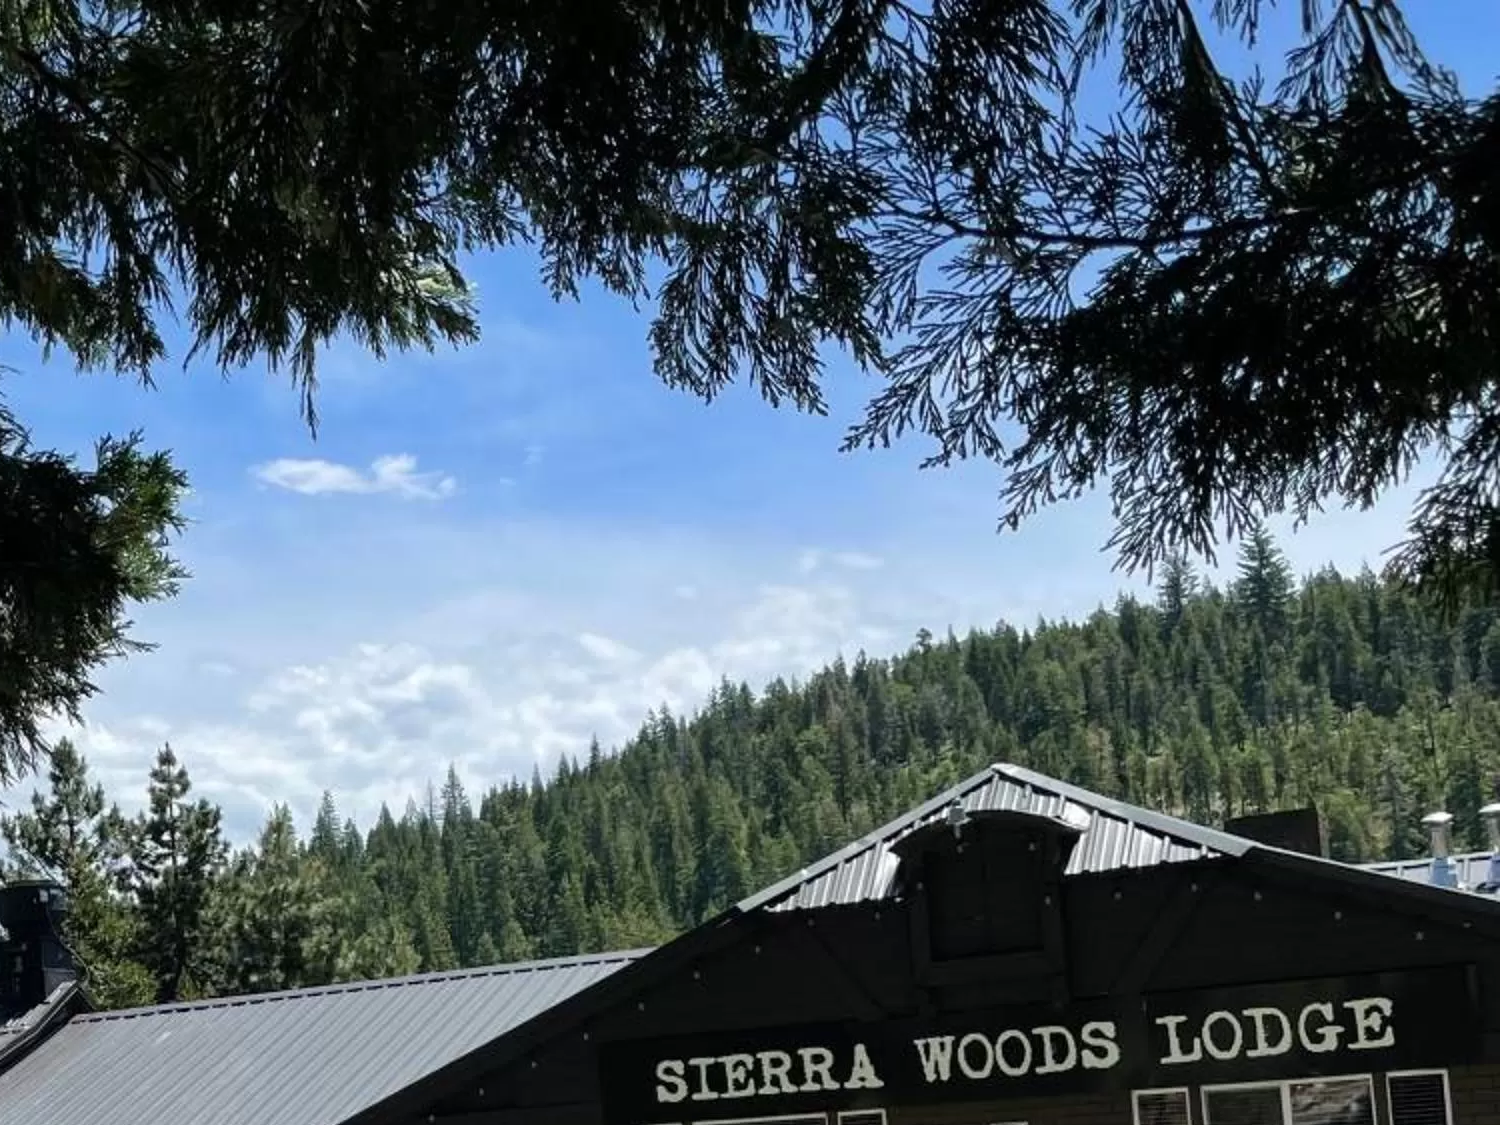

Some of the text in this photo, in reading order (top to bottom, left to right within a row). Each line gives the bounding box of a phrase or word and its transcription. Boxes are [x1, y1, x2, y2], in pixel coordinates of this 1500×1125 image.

[656, 997, 1395, 1103] SIERRA WOODS LODGE
